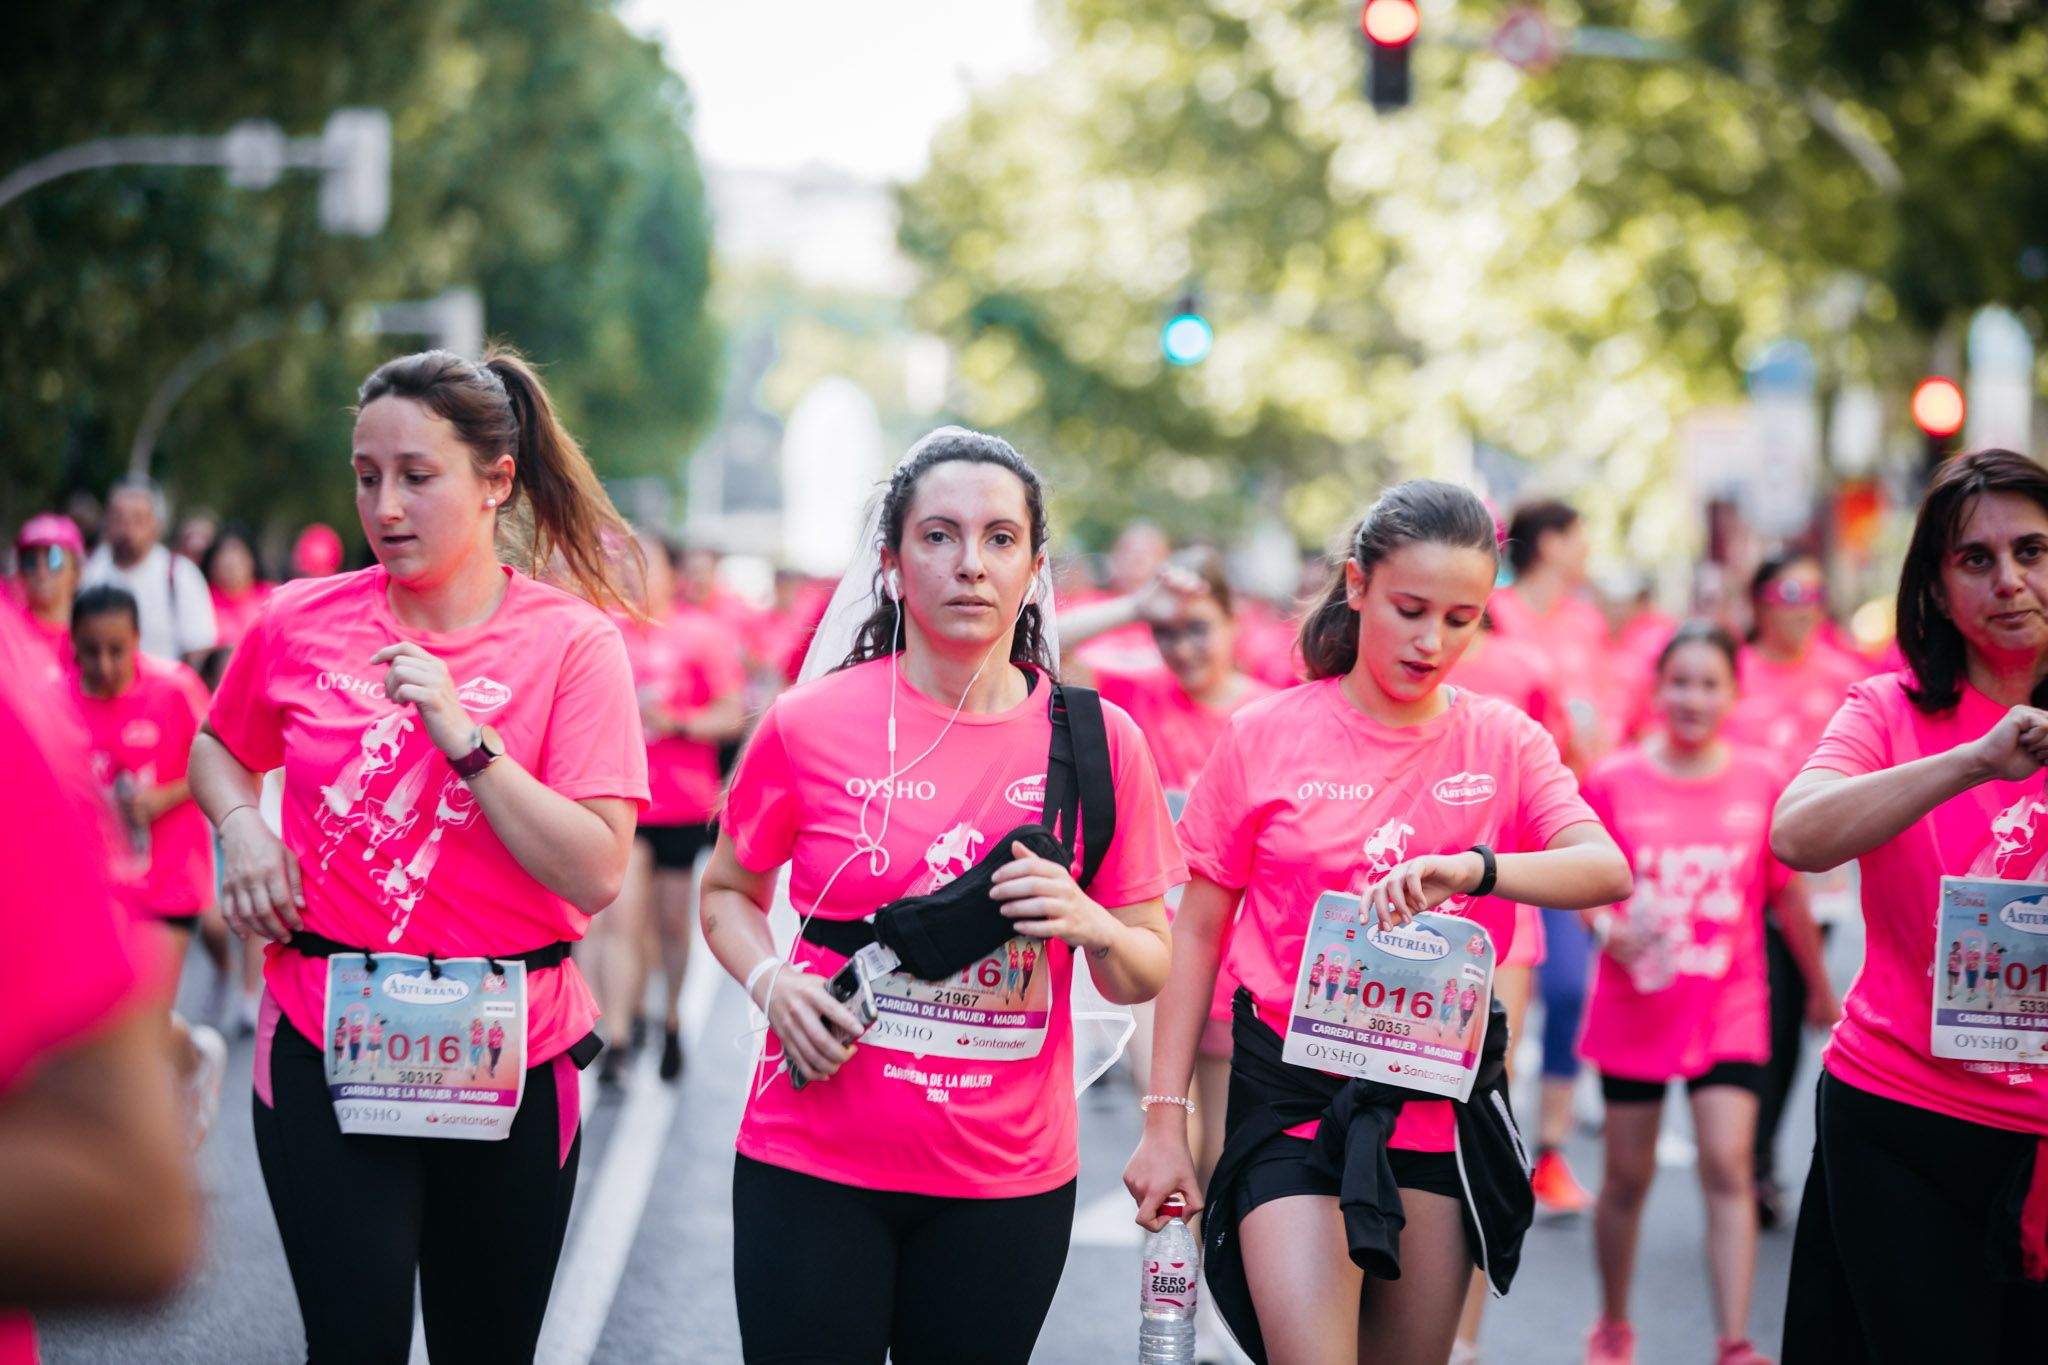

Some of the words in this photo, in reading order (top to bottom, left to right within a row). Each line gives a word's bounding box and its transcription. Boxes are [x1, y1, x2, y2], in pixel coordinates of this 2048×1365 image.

[845, 777, 936, 800] OYSHO
[1298, 782, 1374, 800] OYSHO
[1371, 929, 1444, 956] ASTURIANA
[934, 989, 980, 1008] 21967
[1362, 981, 1435, 1019] 016
[875, 997, 920, 1014] CARRERA
[921, 1005, 935, 1017] DE
[937, 1008, 951, 1020] LA
[952, 1010, 986, 1024] MUJER
[992, 1014, 1026, 1026] MADRID
[1957, 1013, 2002, 1025] CARRERA
[2004, 1016, 2020, 1026] DE
[2020, 1017, 2034, 1027] LA
[1368, 1018, 1411, 1036] 30353
[387, 1033, 462, 1063] 016
[973, 1036, 1027, 1050] Santander
[1311, 1023, 1355, 1040] CARRERA
[1356, 1032, 1370, 1043] DE
[1371, 1035, 1384, 1046] LA
[1384, 1037, 1418, 1052] MUJER
[1423, 1045, 1463, 1061] MADRID
[1955, 1033, 2018, 1051] OYSHO
[1306, 1043, 1367, 1067] OYSHO
[399, 1070, 443, 1085] 30312
[883, 1063, 928, 1086] CARRERA
[929, 1073, 943, 1087] DE
[945, 1074, 958, 1088] LA
[960, 1074, 993, 1088] MUJER
[1403, 1064, 1463, 1085] Santander
[459, 1090, 499, 1102] MADRID
[341, 1106, 401, 1121] OYSHO
[441, 1112, 499, 1127] Santander
[1151, 1284, 1187, 1294] SODIO
[1152, 1275, 1186, 1286] ZERO
